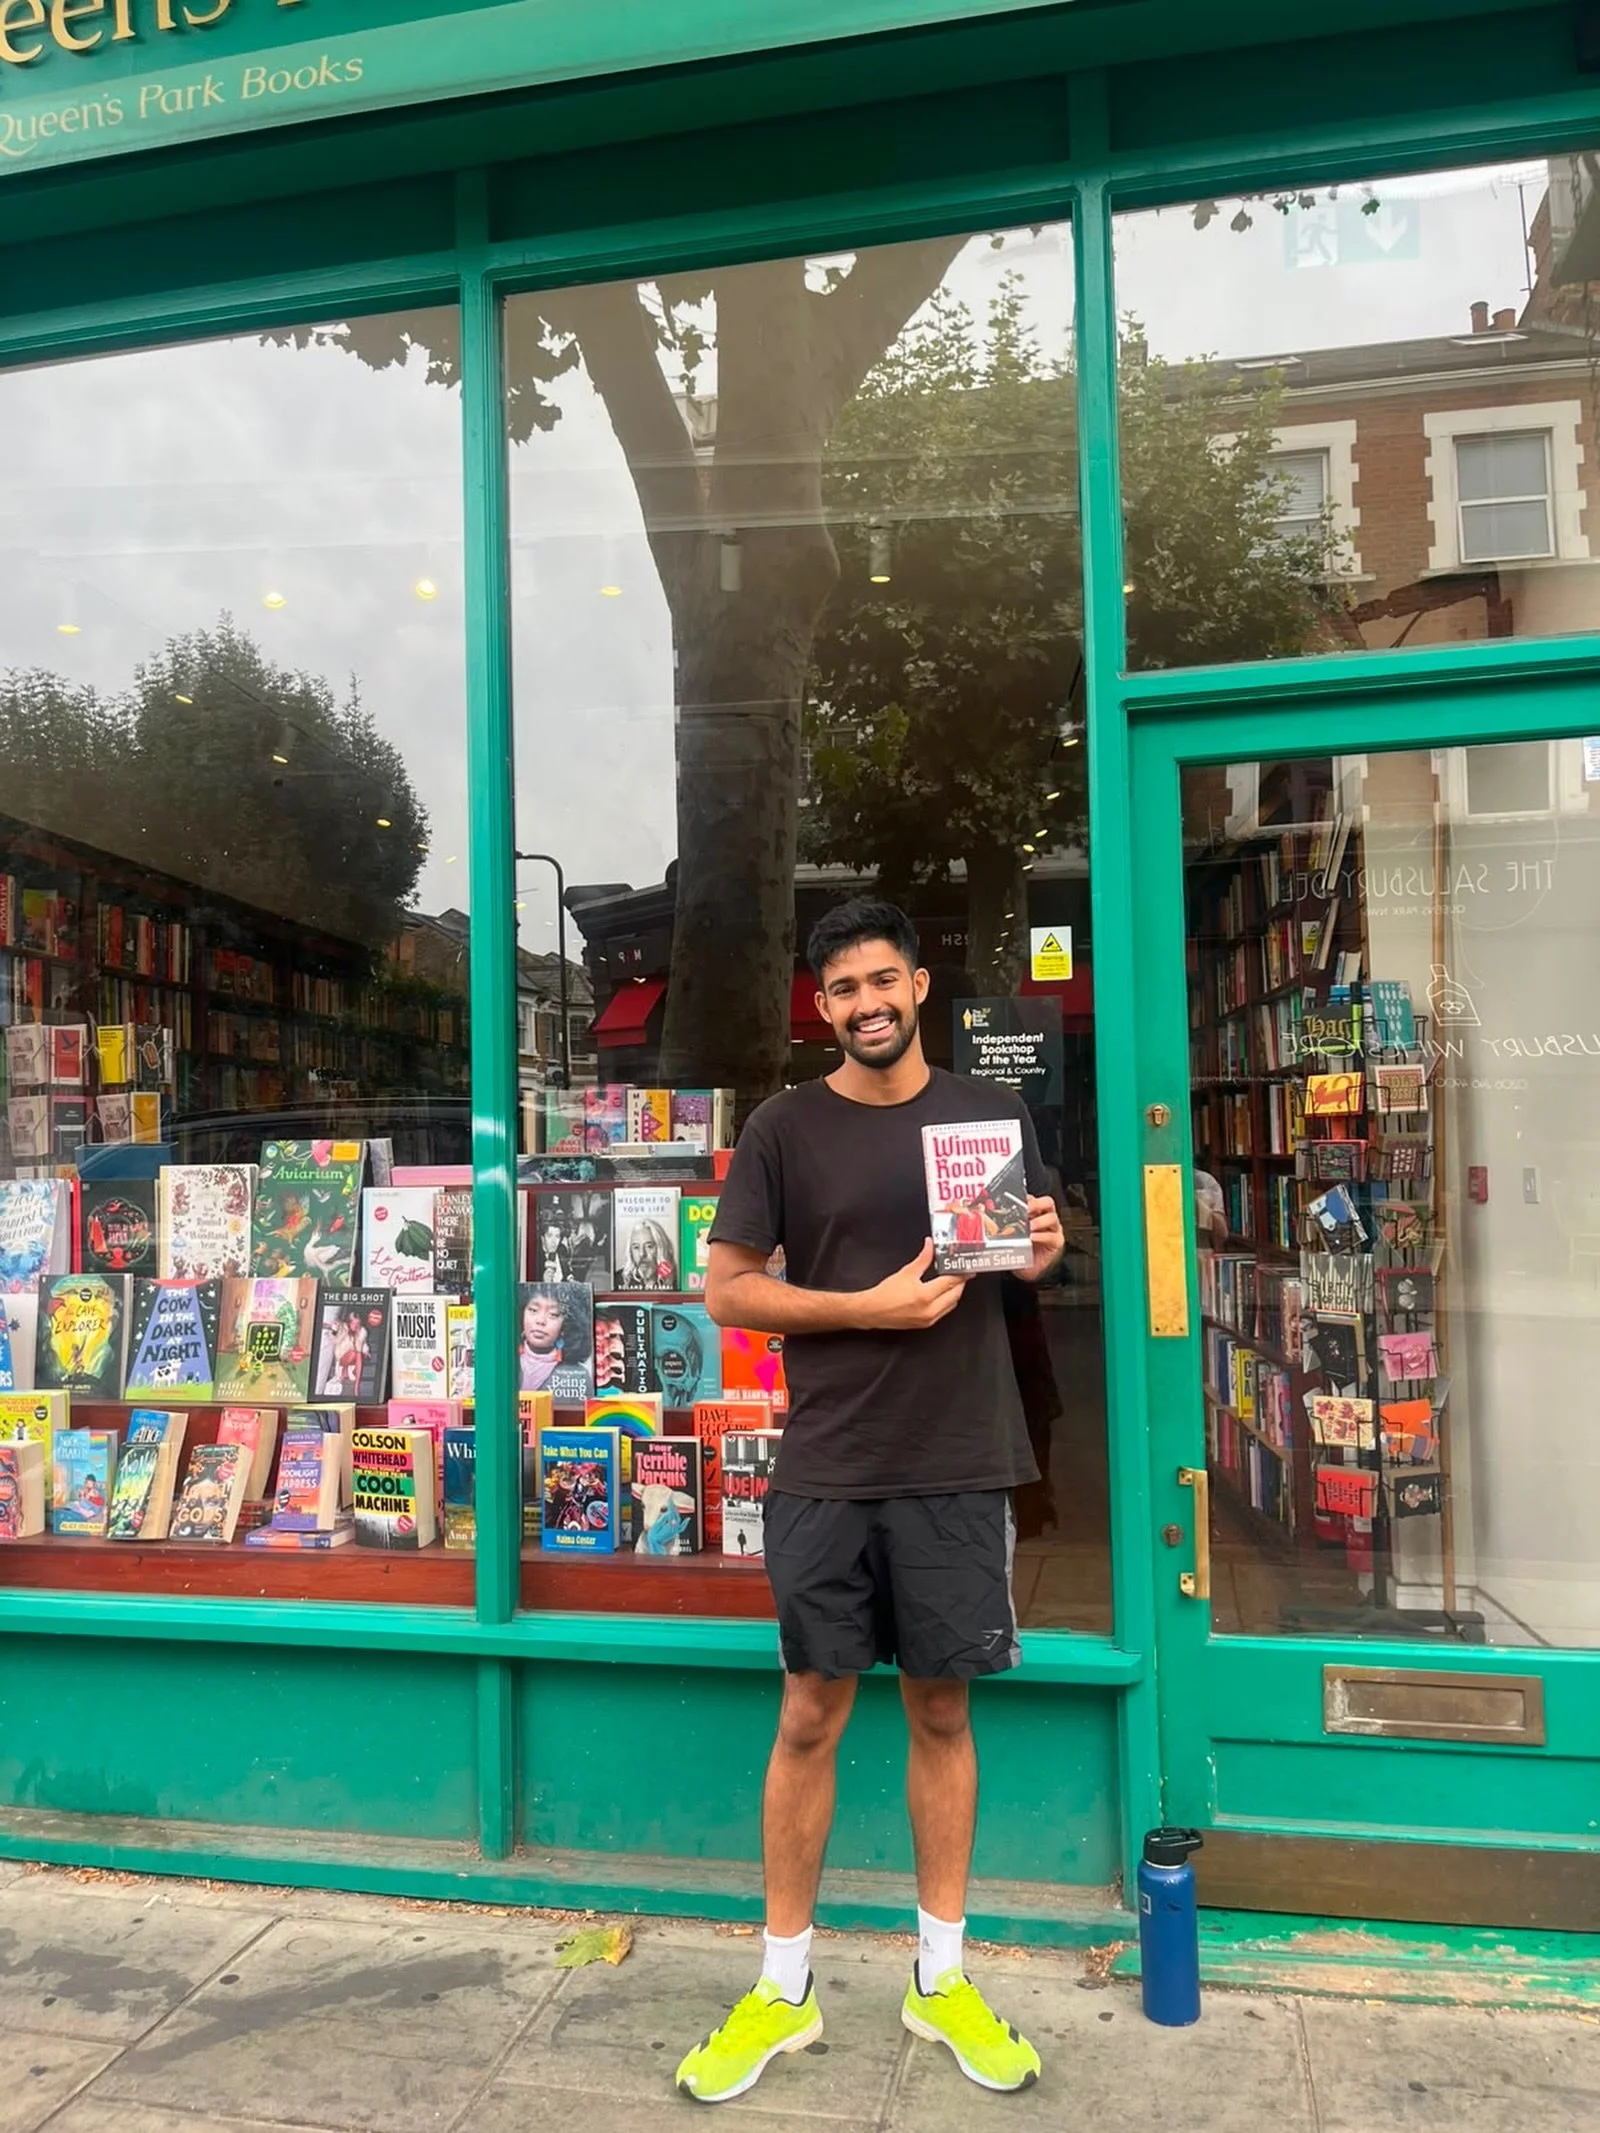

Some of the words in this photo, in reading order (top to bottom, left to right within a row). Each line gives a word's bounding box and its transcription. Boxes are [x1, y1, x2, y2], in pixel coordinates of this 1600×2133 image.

[139, 75, 225, 119] Park
[241, 55, 364, 100] Books
[972, 1032, 1044, 1045] Independent
[981, 1044, 1035, 1055] Bookshop
[979, 1055, 990, 1065] of
[992, 1055, 1010, 1064] the
[1013, 1054, 1037, 1064] Year
[970, 1068, 1005, 1077] Regional
[933, 1134, 1012, 1158] Wimmy
[273, 1166, 344, 1180] Aviarium
[936, 1157, 986, 1179] Road
[436, 1194, 472, 1204] STANLEY
[618, 1197, 656, 1205] WELCOME
[436, 1205, 473, 1216] DONWOO
[648, 1205, 665, 1213] LIFE
[688, 1204, 717, 1222] DO
[437, 1216, 459, 1226] THERE
[437, 1227, 455, 1237] WILL
[437, 1238, 447, 1248] BE
[437, 1249, 449, 1259] NO
[436, 1260, 458, 1270] QUIET
[166, 1288, 190, 1297] THE
[323, 1292, 340, 1300] THE
[343, 1293, 358, 1301] BIG
[360, 1294, 385, 1302] SHOT
[76, 1305, 97, 1317] CAVE
[158, 1298, 192, 1313] COW
[397, 1302, 422, 1314] TONIGHT
[424, 1302, 435, 1314] THE
[159, 1313, 174, 1323] IN
[176, 1312, 195, 1321] THE
[55, 1319, 106, 1334] EXPLORER
[151, 1322, 197, 1340] DARK
[397, 1314, 436, 1338] MUSIC
[397, 1339, 414, 1349] SEEMS
[636, 1309, 648, 1393] SUBLIMATIO
[141, 1342, 202, 1363] NIGHT
[552, 1375, 587, 1389] Being
[547, 1385, 587, 1401] Young
[700, 1409, 732, 1423] DAVE
[352, 1433, 406, 1450] COLSON
[447, 1443, 476, 1458] Whi
[543, 1445, 558, 1457] Take
[560, 1446, 577, 1458] What
[579, 1447, 593, 1458] You
[594, 1447, 609, 1459] Can
[352, 1450, 407, 1467] WHITEHEAD
[635, 1452, 688, 1471] Terrible
[280, 1468, 320, 1478] MOONLIGHT
[637, 1468, 687, 1487] Parents
[279, 1479, 317, 1488] EXPRESS
[357, 1475, 405, 1495] COOL
[724, 1476, 769, 1497] WEIM
[355, 1494, 410, 1513] MACHINE
[178, 1508, 222, 1522] GOS
[448, 1531, 467, 1540] Ann
